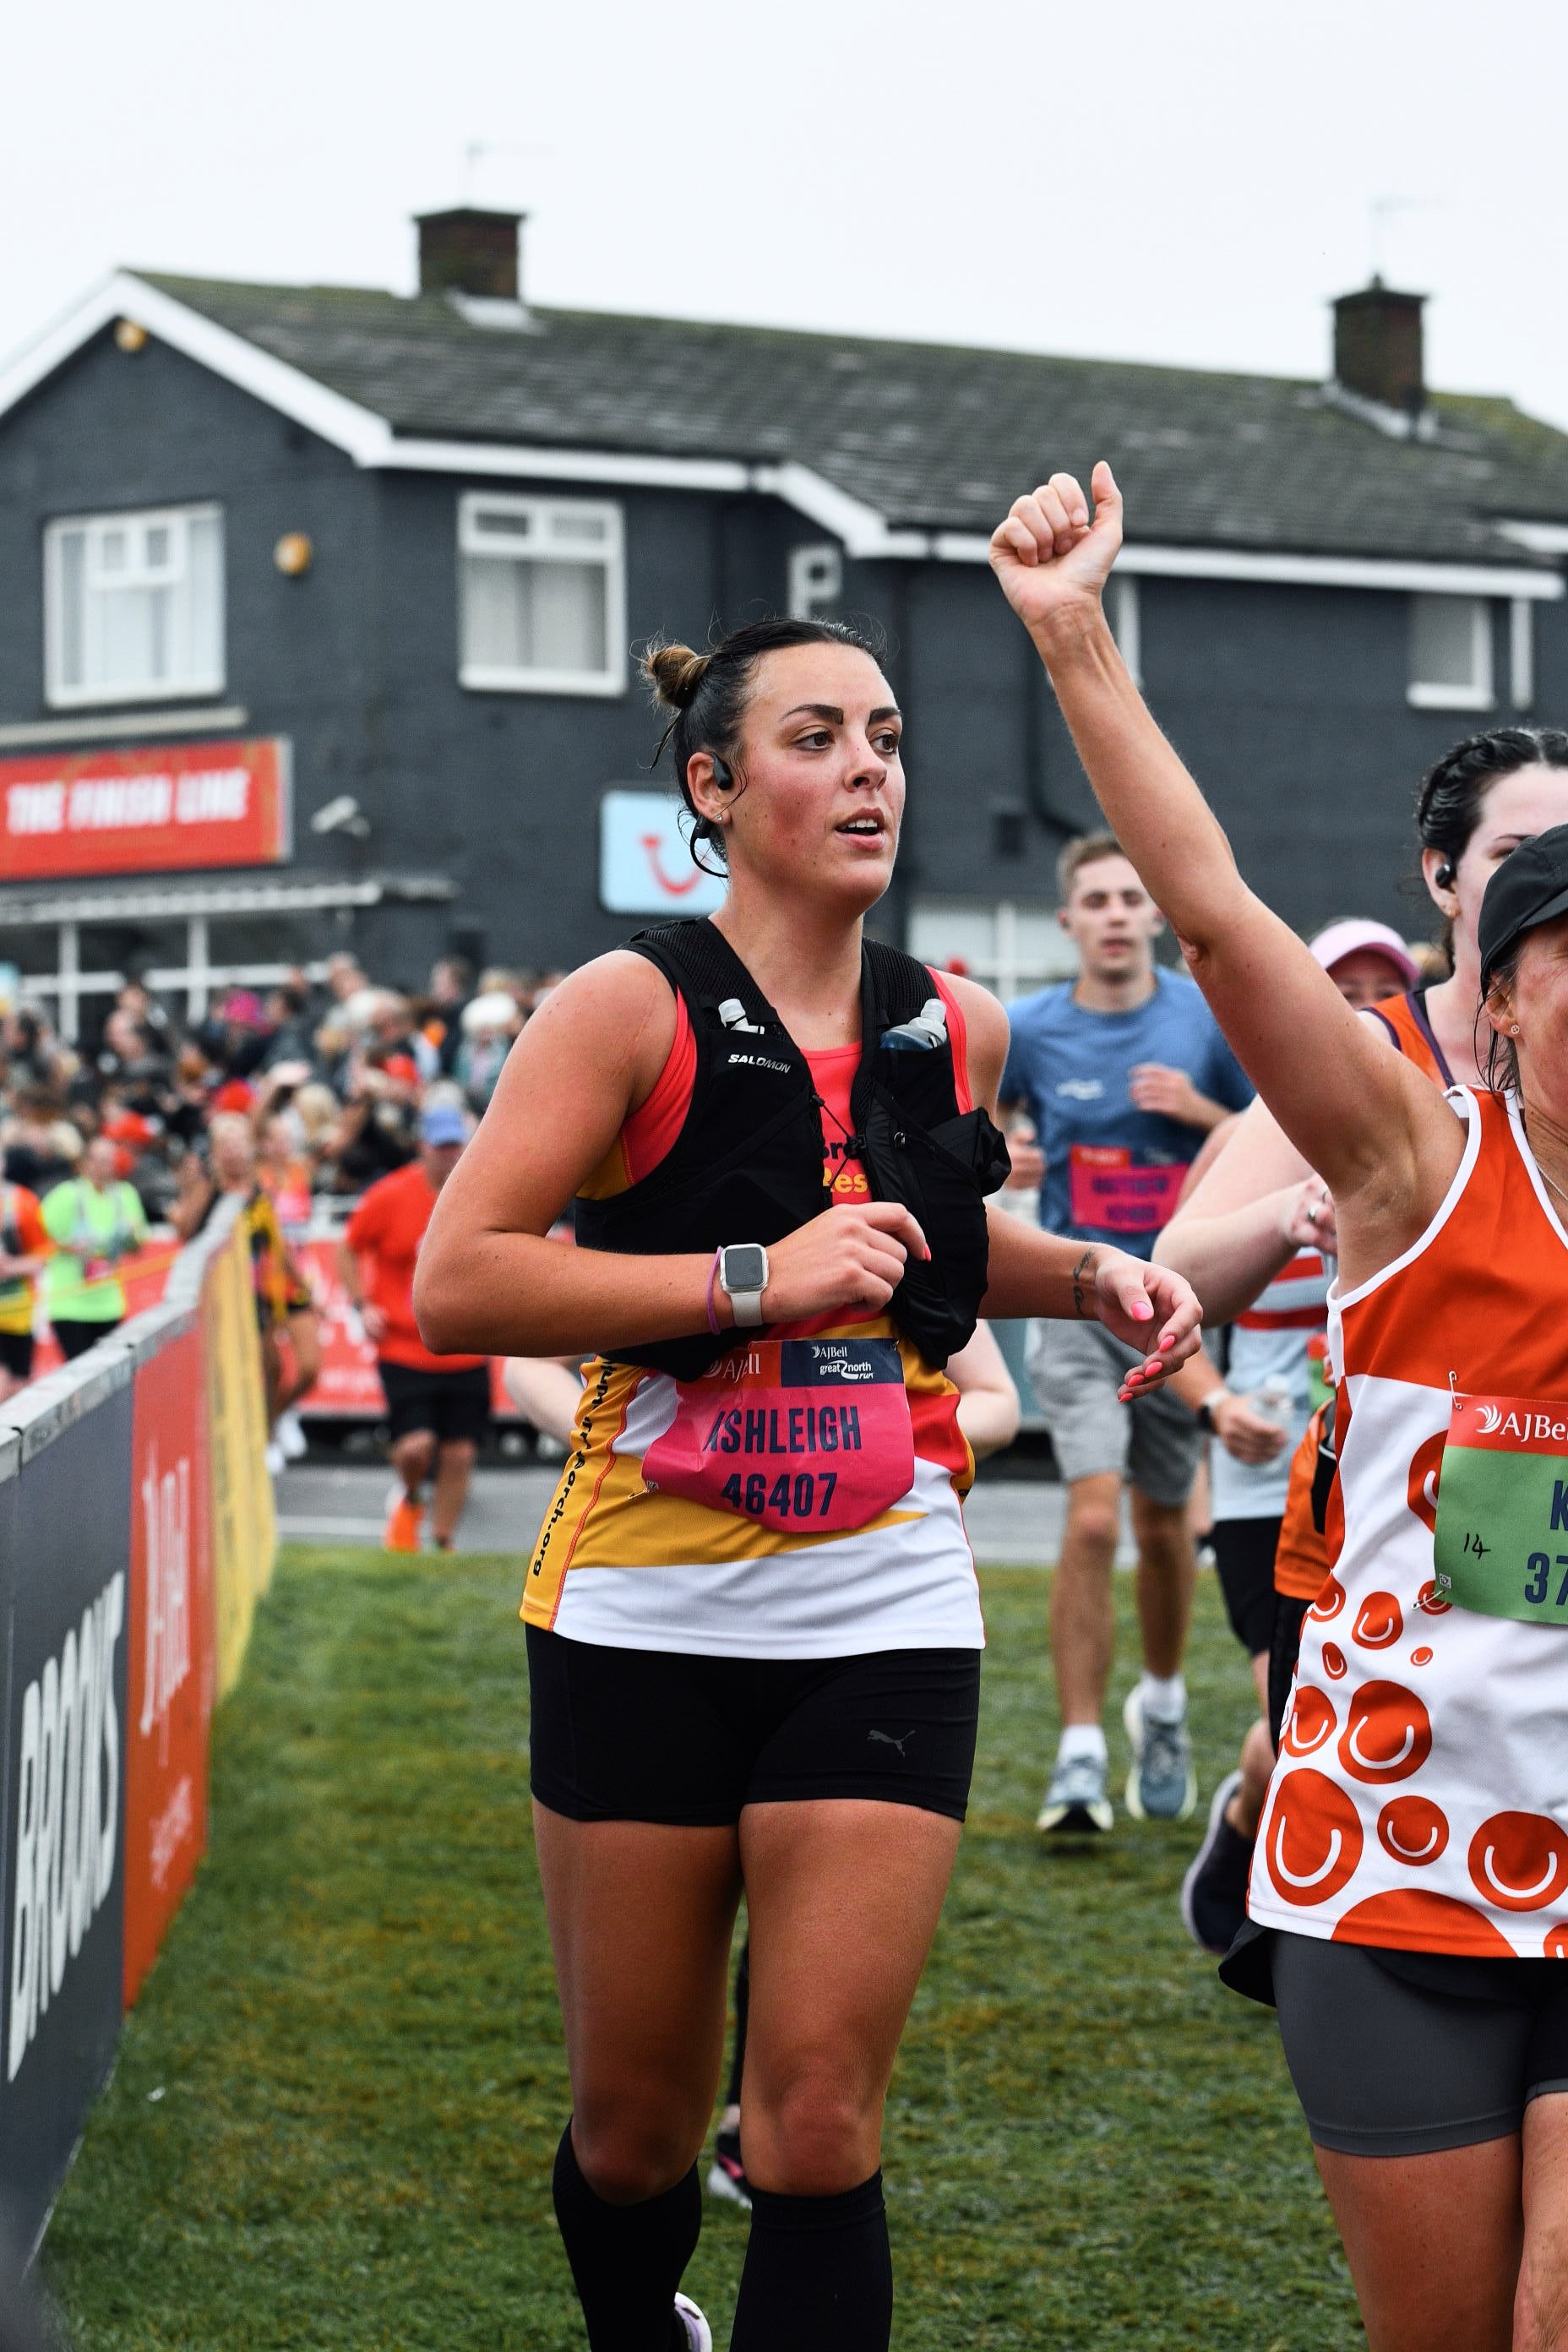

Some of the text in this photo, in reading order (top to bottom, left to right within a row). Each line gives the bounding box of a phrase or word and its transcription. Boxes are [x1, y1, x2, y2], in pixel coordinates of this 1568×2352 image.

[8, 781, 63, 834] THE
[727, 1054, 792, 1074] SALOMON
[819, 1345, 847, 1360] AJBell
[819, 1361, 872, 1375] great north
[1499, 1412, 1568, 1443] AJBe
[721, 1473, 838, 1517] 46407
[1463, 1533, 1492, 1560] 14
[8, 1571, 125, 2082] BROOKS
